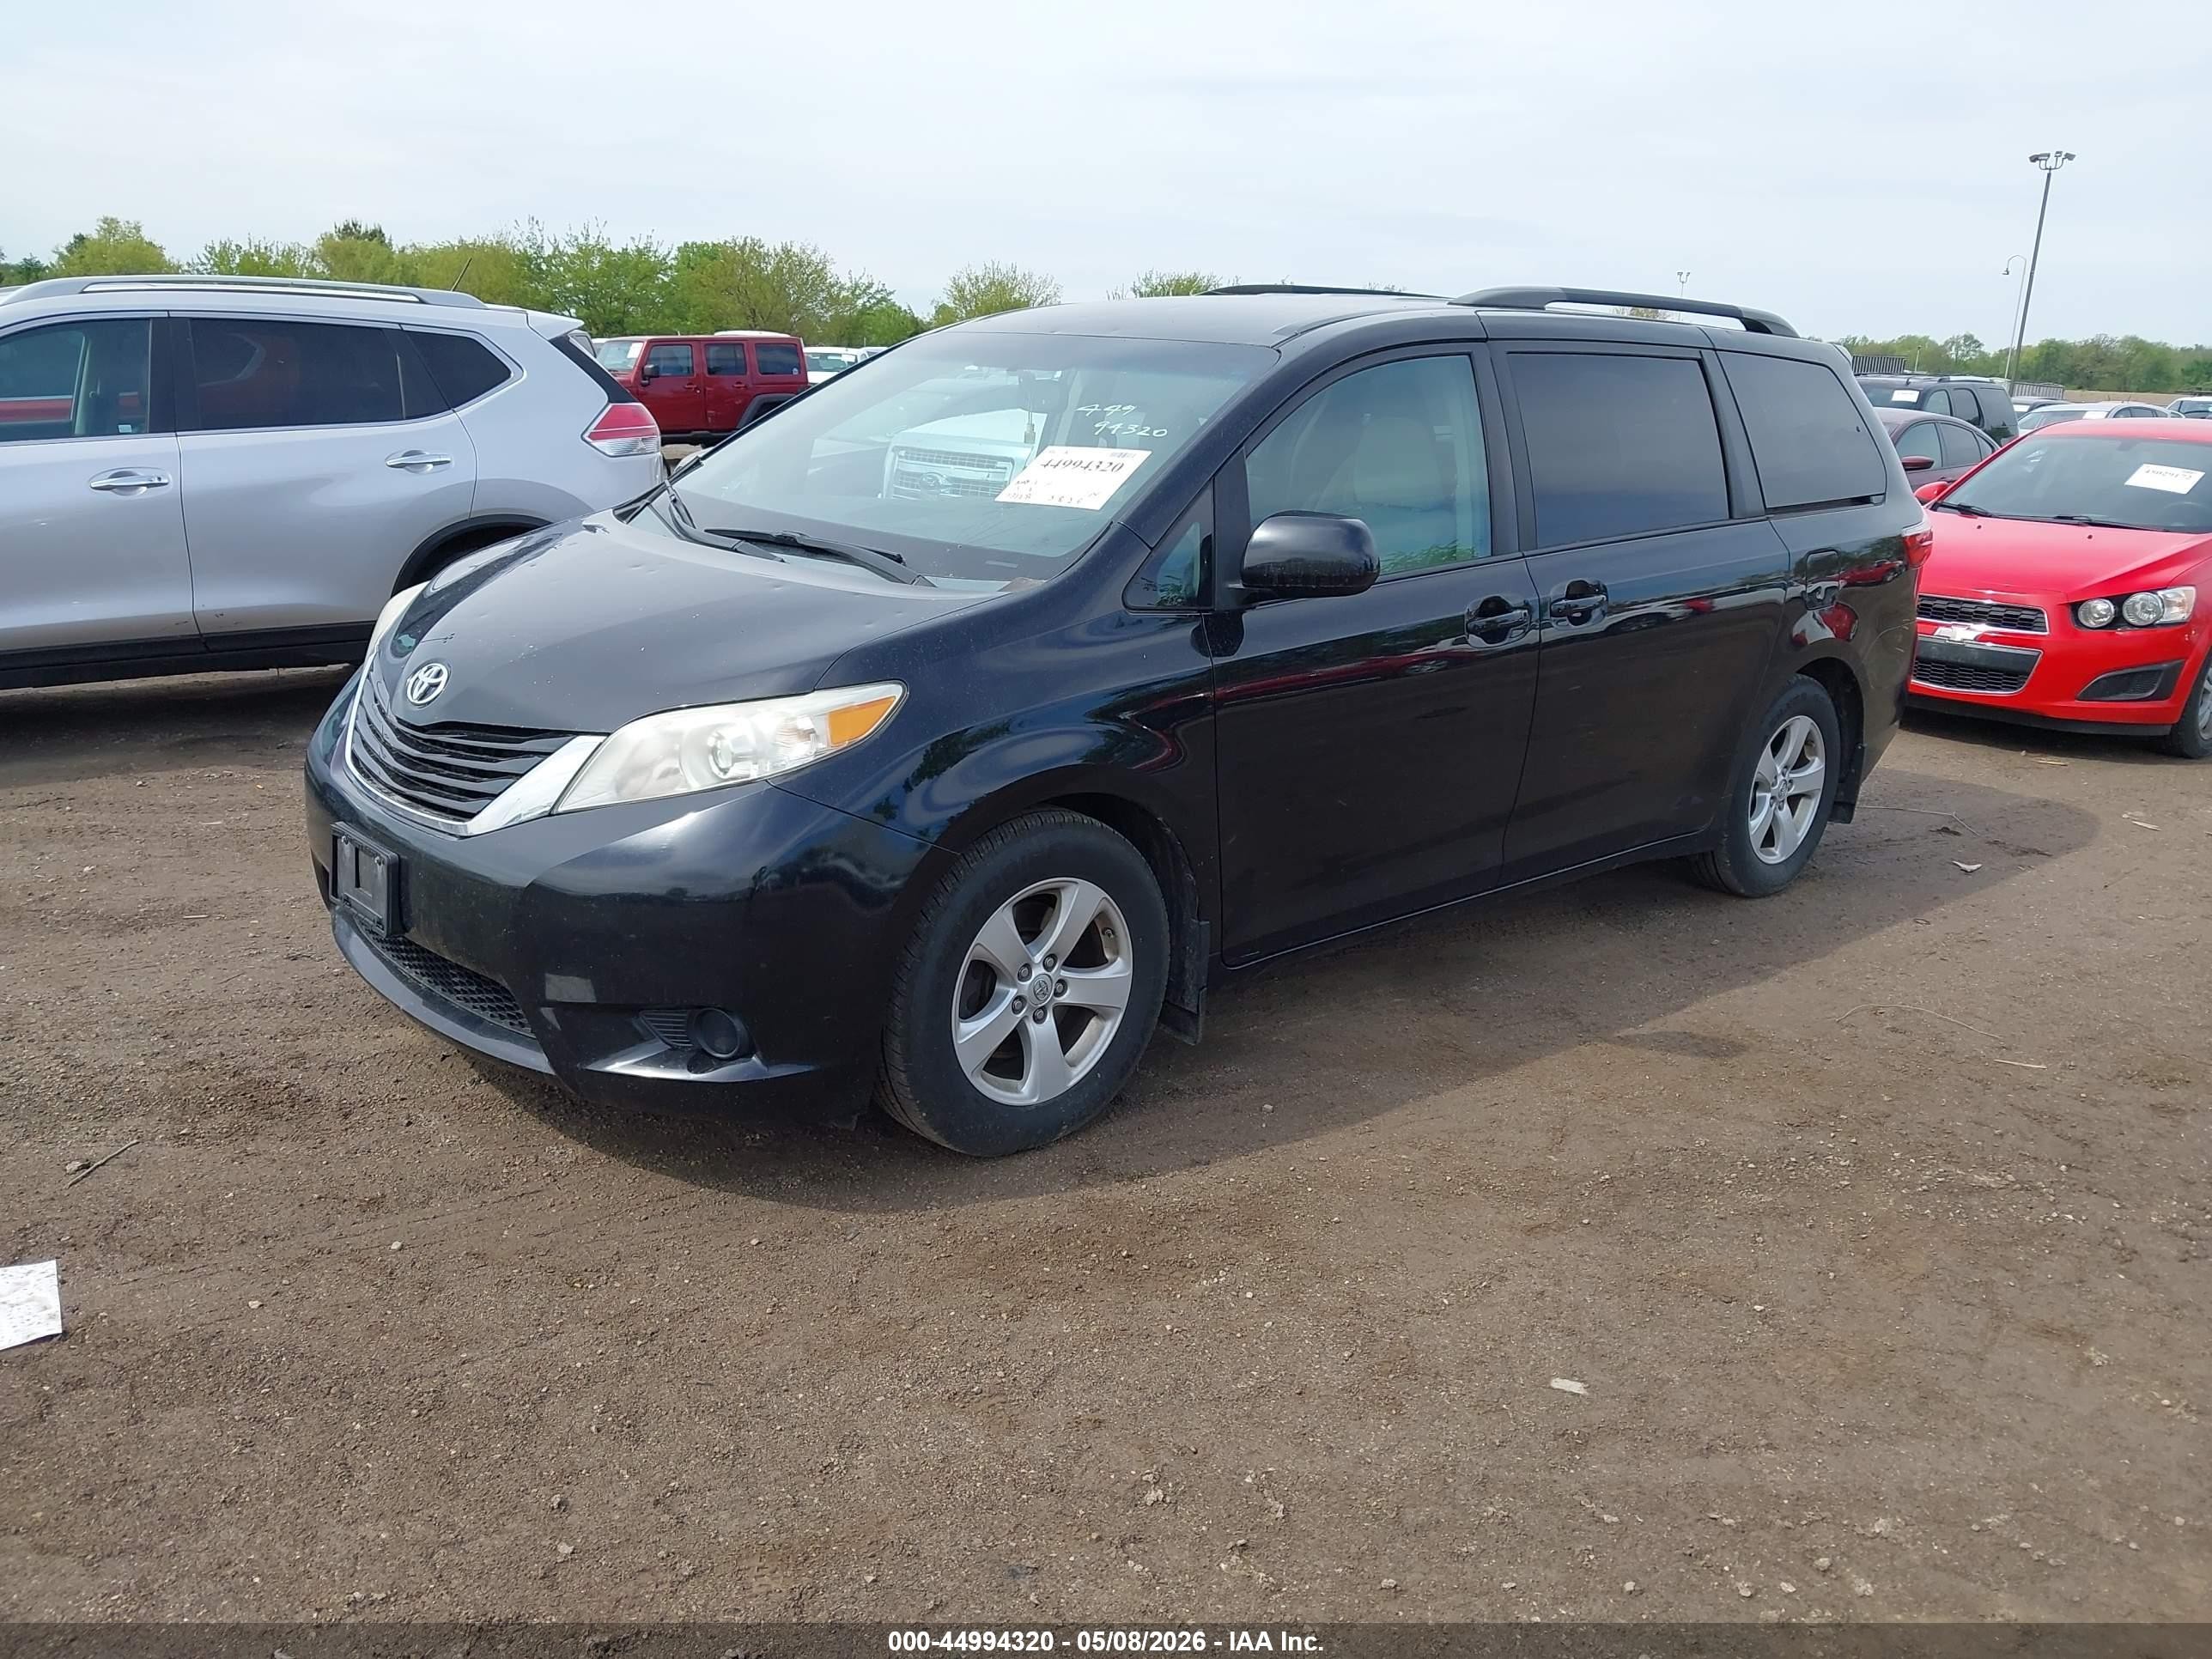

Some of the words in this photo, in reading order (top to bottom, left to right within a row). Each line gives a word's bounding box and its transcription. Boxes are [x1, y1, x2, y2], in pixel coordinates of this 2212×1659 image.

[1076, 404, 1138, 417] 449
[1093, 421, 1169, 437] 94320
[1040, 459, 1125, 473] 44994320
